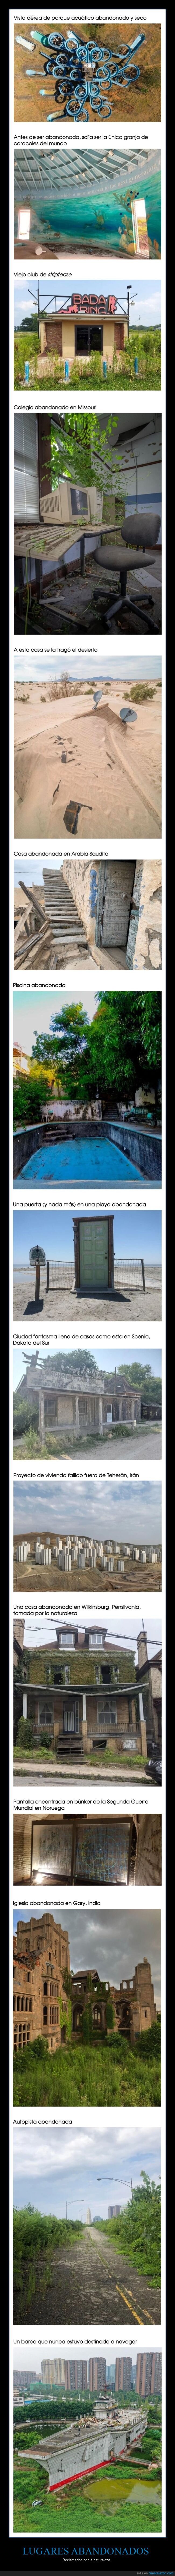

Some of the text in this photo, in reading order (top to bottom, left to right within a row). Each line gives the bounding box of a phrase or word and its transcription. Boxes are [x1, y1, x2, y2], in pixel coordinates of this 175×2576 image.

[129, 163, 157, 184] generation
[73, 294, 106, 304] BADA
[40, 1369, 72, 1379] LONGHORN
